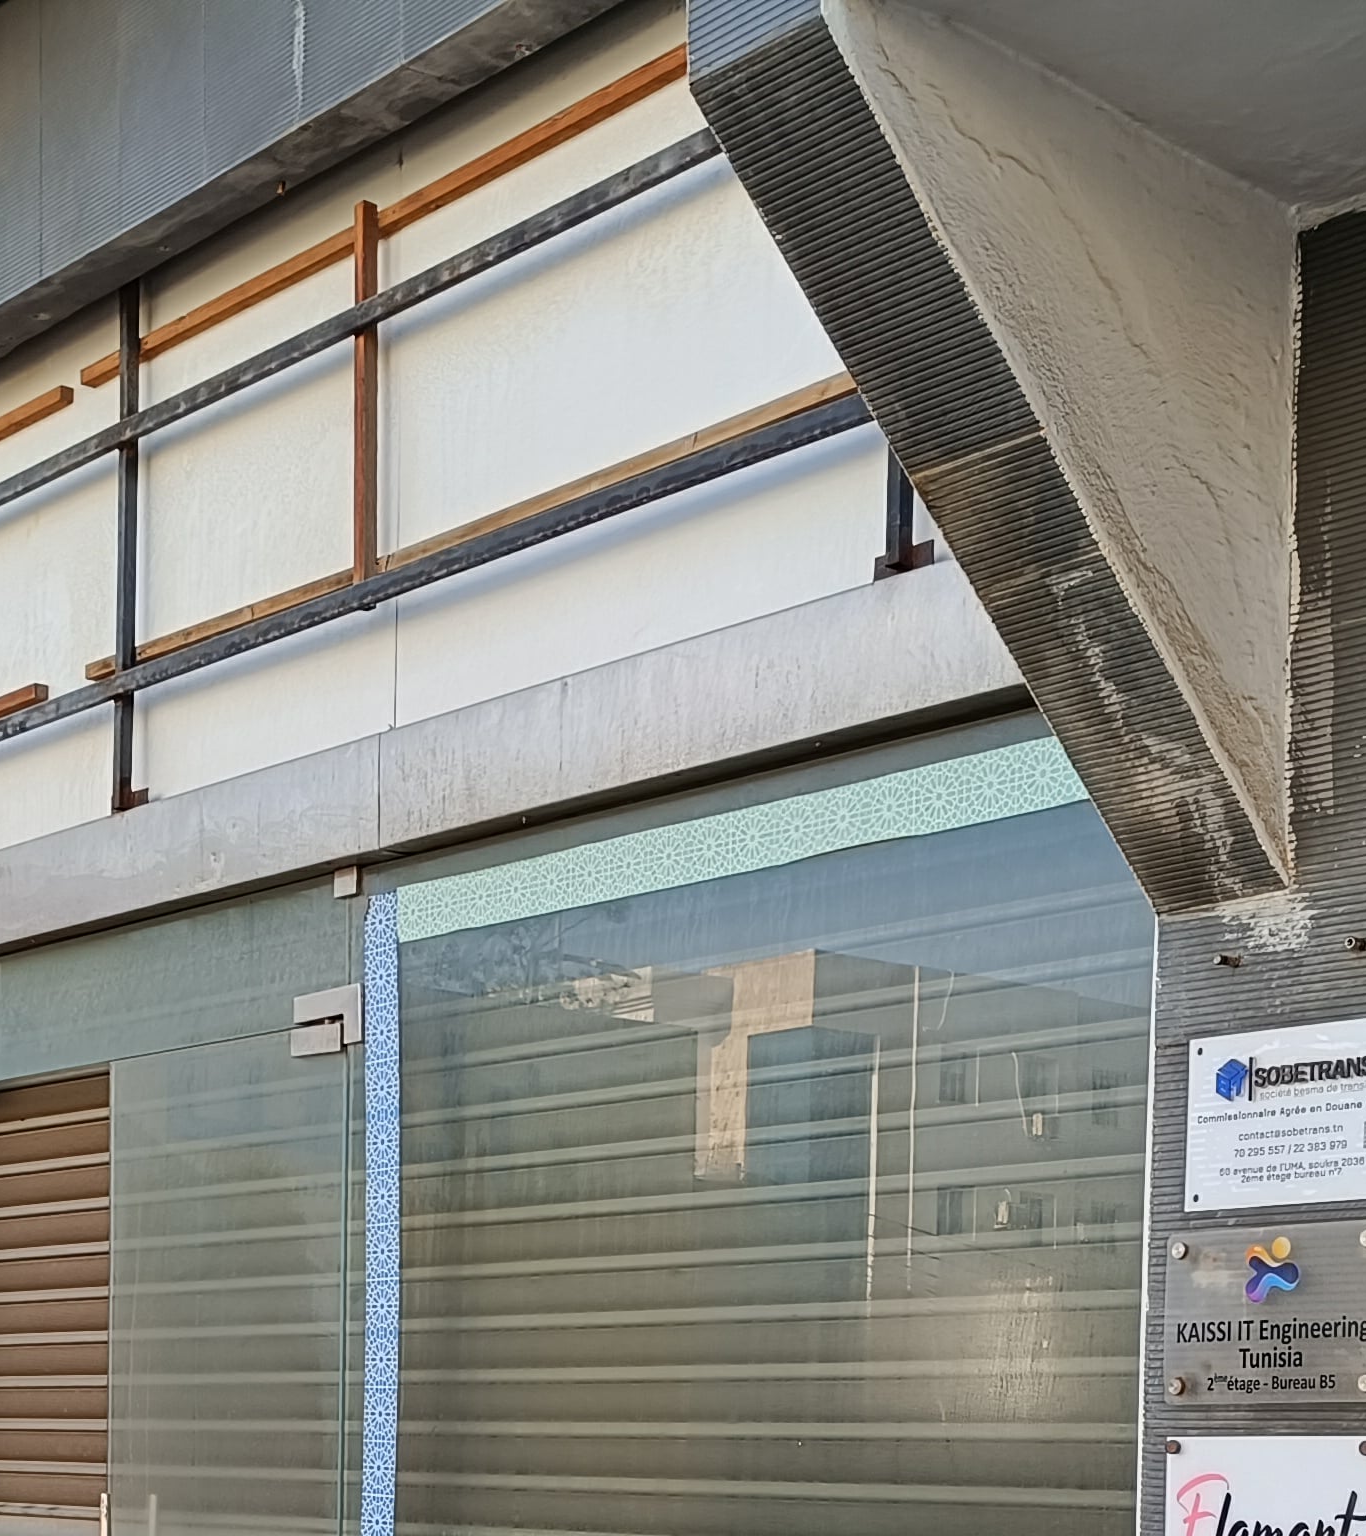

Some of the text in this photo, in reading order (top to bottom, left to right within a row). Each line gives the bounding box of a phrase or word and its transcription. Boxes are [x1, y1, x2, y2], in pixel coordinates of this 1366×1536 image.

[1326, 1083, 1338, 1093] de
[1197, 1108, 1276, 1124] Commissionnaire
[1309, 1105, 1322, 1113] en
[1325, 1101, 1362, 1112] Douane
[1238, 1124, 1344, 1141] contact@sobetrans.tn
[1233, 1148, 1246, 1158] 70
[1247, 1146, 1265, 1157] 295
[1267, 1144, 1285, 1155] 557
[1293, 1143, 1305, 1153] 22
[1307, 1141, 1327, 1152] 383
[1233, 1166, 1264, 1176] avenue
[1266, 1163, 1277, 1173] de
[1294, 1170, 1326, 1179] bureau
[1176, 1321, 1232, 1344] KAISSI
[1237, 1319, 1254, 1342] IT
[1238, 1346, 1304, 1369] Tunisia
[1271, 1375, 1316, 1390] Bureau
[1319, 1374, 1336, 1389] B5
